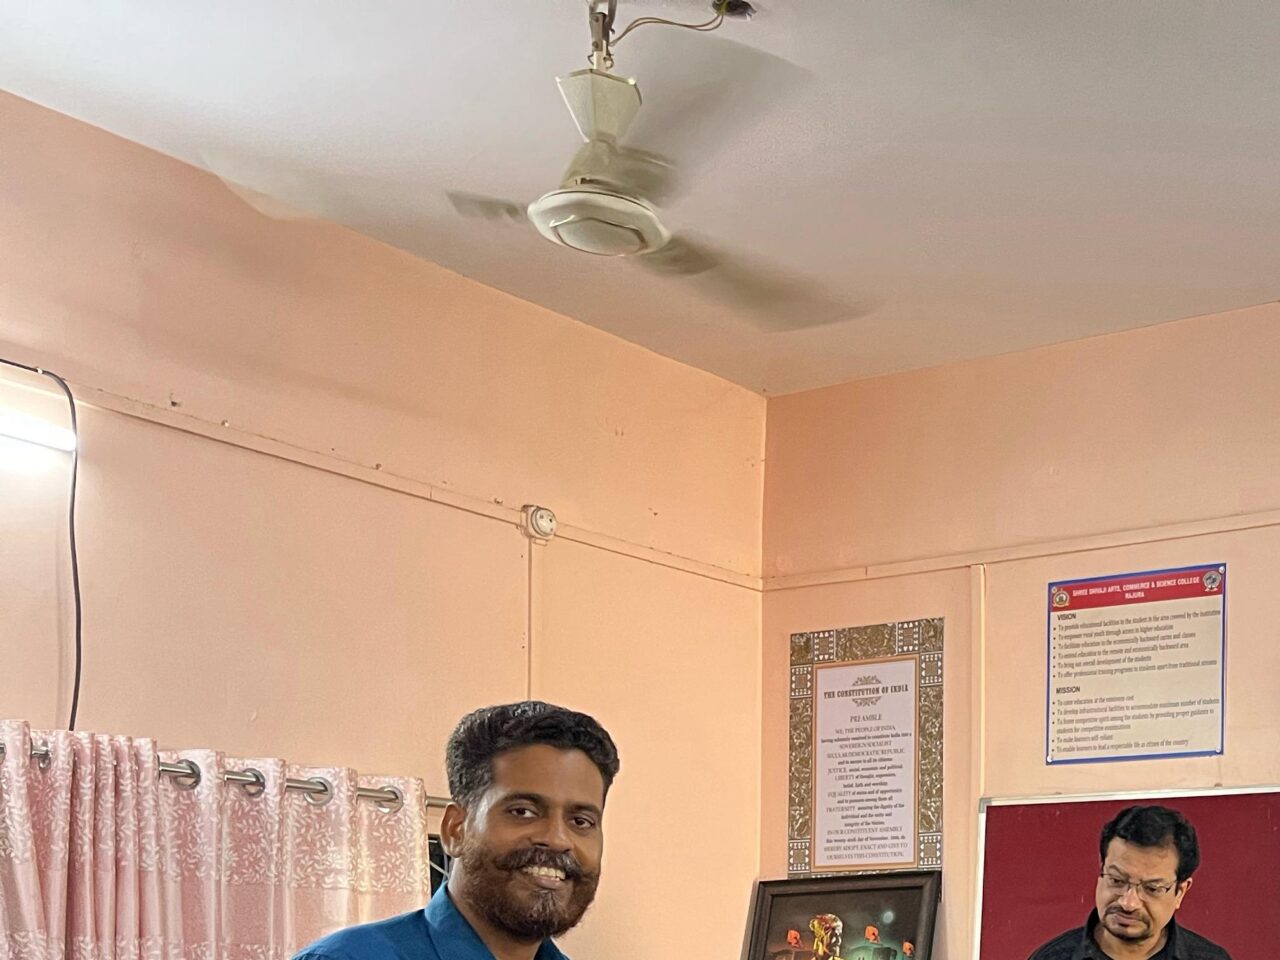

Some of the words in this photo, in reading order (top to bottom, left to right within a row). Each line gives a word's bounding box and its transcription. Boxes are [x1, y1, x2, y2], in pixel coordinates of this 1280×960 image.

[1178, 576, 1200, 585] COLLEGE
[824, 690, 836, 700] THE
[836, 687, 880, 698] CONSTITUTION
[882, 686, 889, 694] OF
[890, 684, 908, 693] INDIA
[1056, 686, 1080, 694] MISSION
